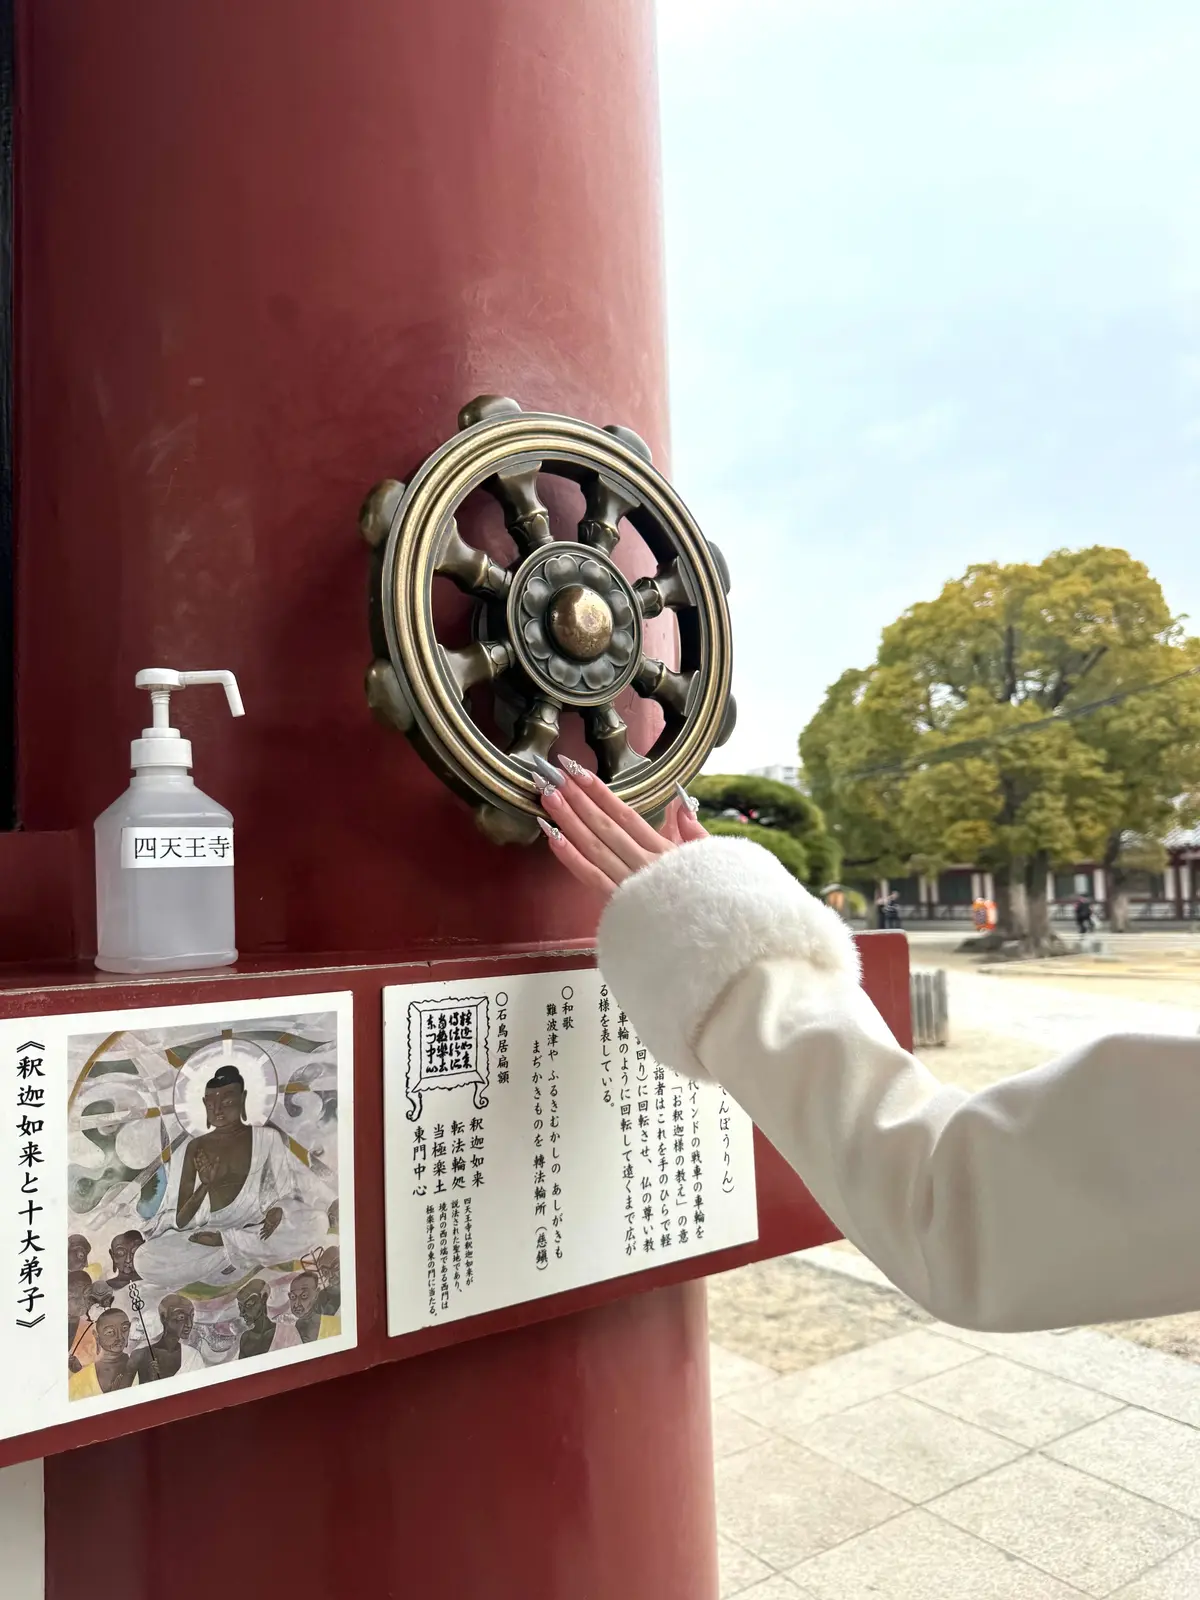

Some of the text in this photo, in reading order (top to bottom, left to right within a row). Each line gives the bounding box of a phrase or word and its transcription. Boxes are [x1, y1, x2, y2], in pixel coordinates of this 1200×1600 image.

[134, 836, 231, 860] 四天王寺
[598, 984, 615, 1108] る様を表している。
[413, 1125, 427, 1196] 東門中心
[431, 1123, 447, 1194] 当極楽土
[451, 1120, 467, 1190] 転法輪処
[469, 1117, 485, 1188] 釈迦如来
[617, 1004, 637, 1256] 車輪のように回転して遠くまで広が
[653, 1061, 672, 1249] 詣者はこれを手のひらで軽
[15, 1040, 46, 1329] 《釈迦如来と十大弟子》
[439, 1202, 449, 1310] 境内の西の端である西門は
[463, 1197, 473, 1286] 四天王寺は釈迦如来が
